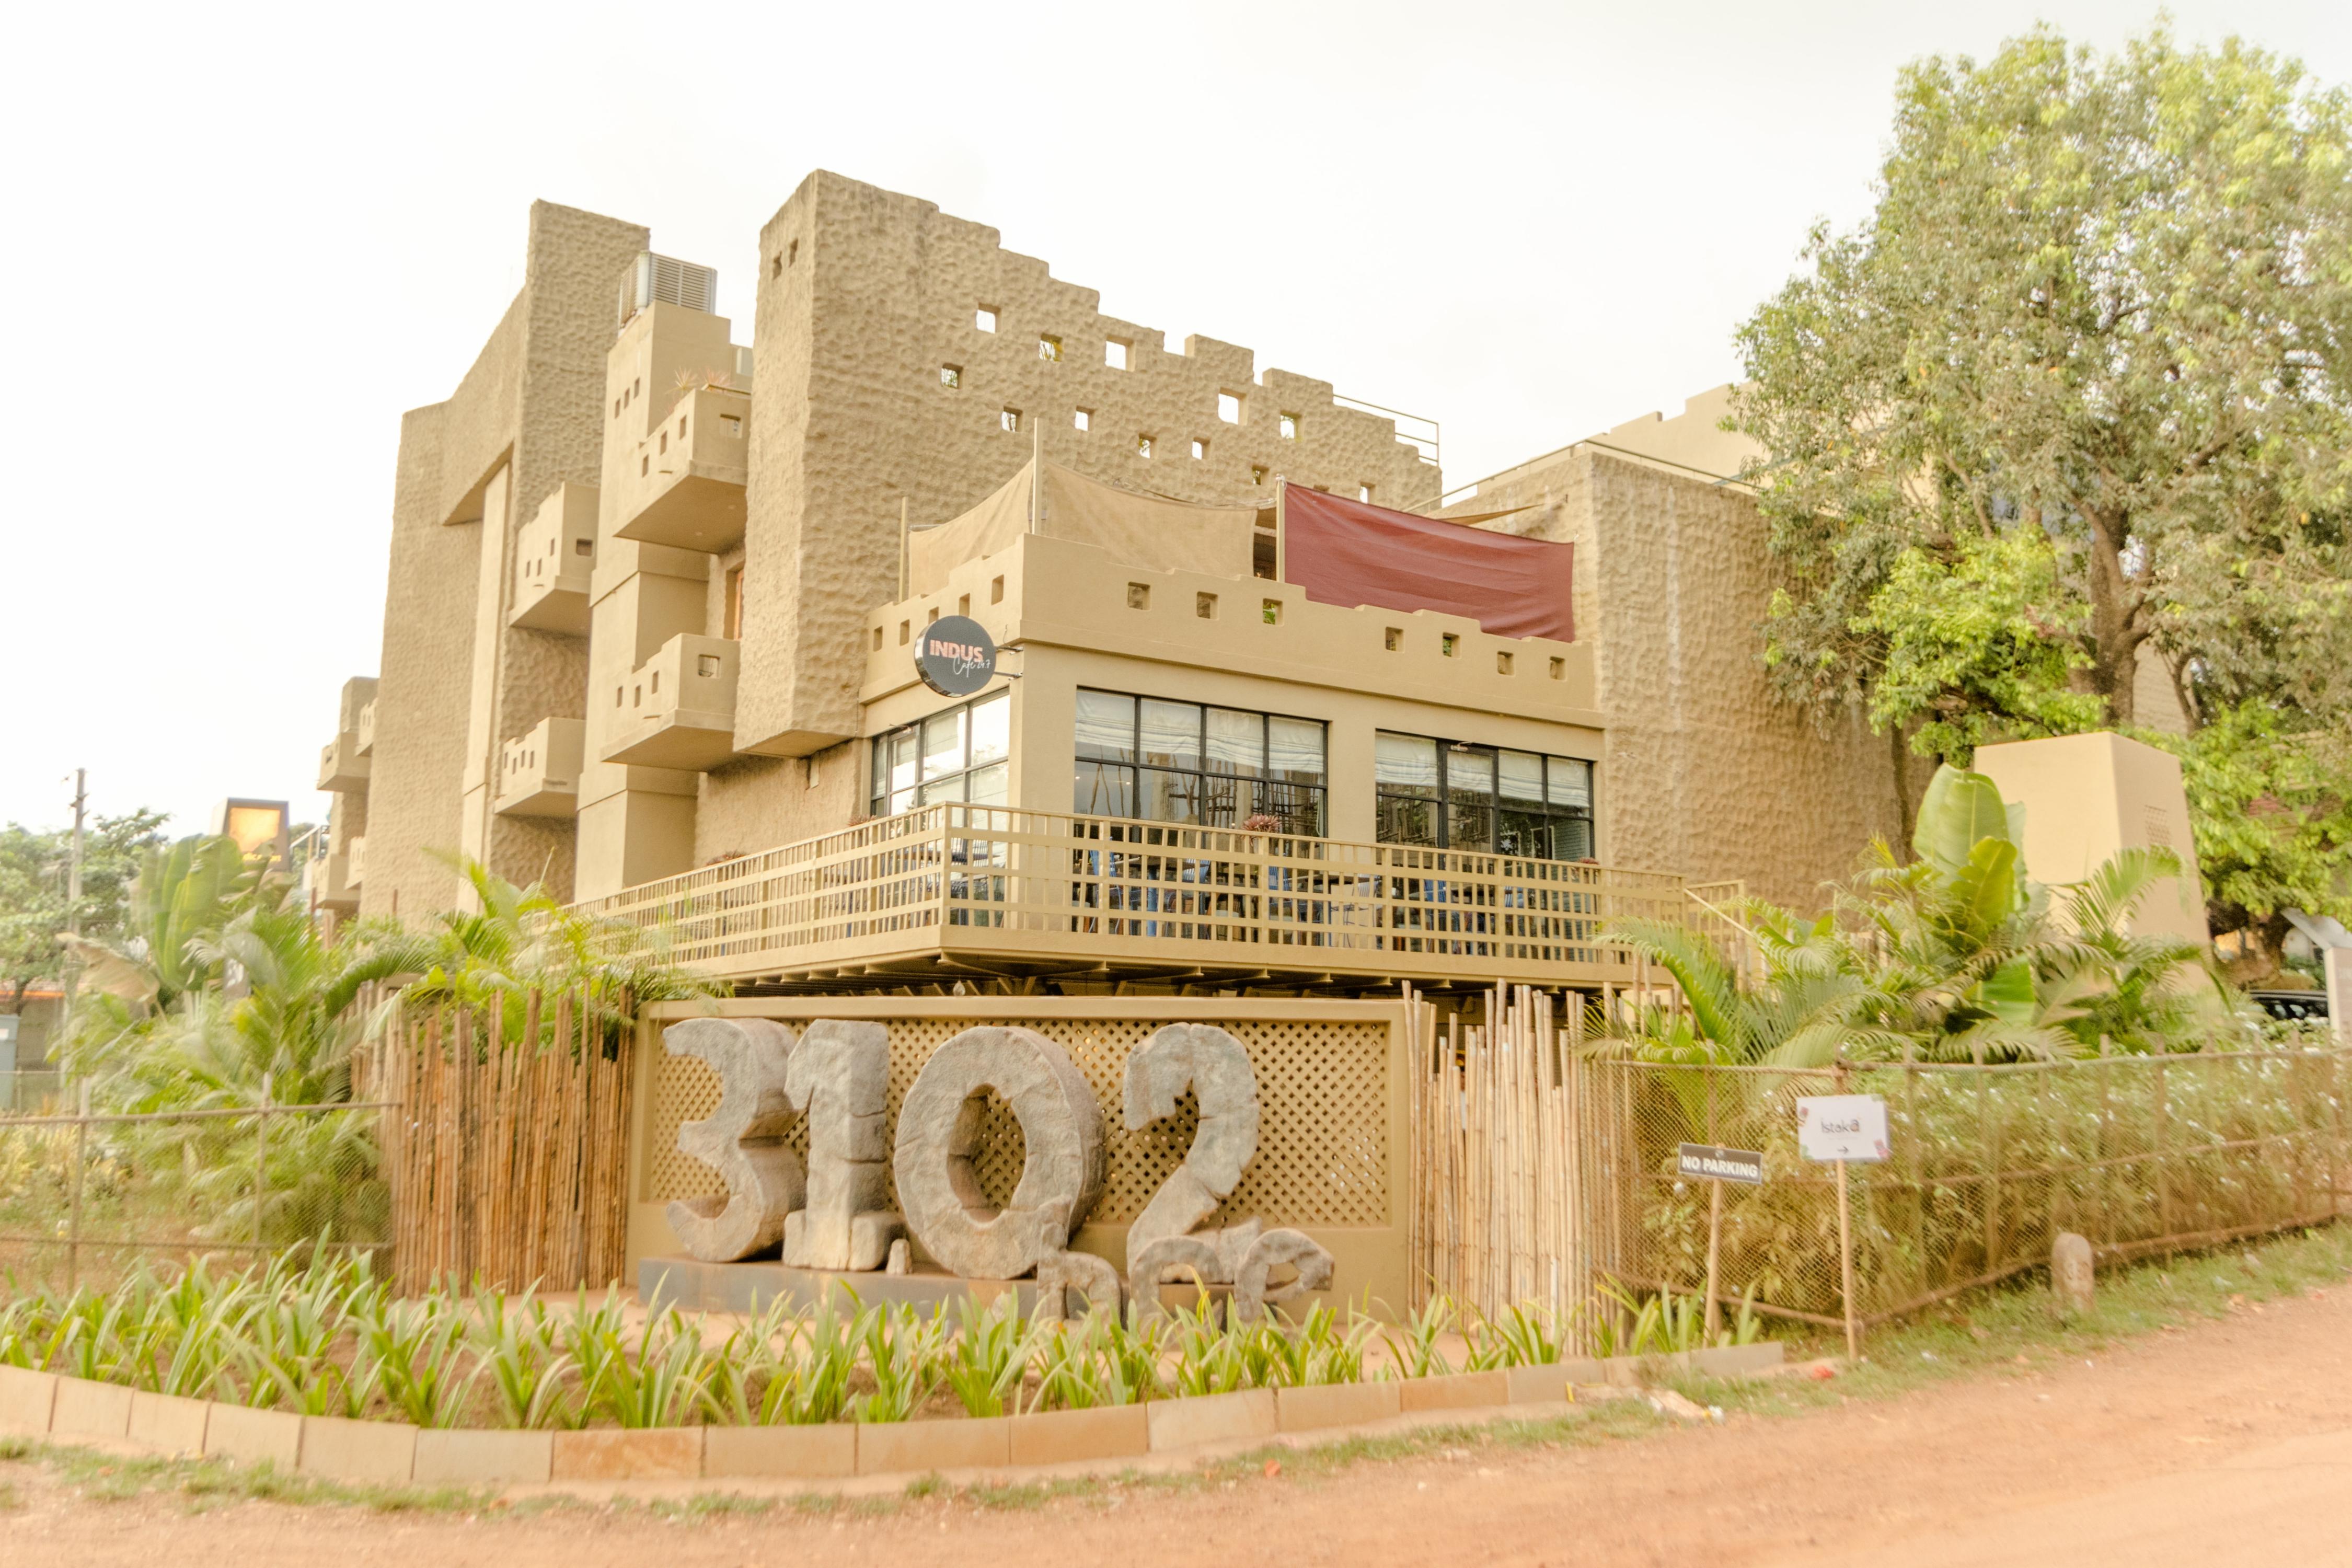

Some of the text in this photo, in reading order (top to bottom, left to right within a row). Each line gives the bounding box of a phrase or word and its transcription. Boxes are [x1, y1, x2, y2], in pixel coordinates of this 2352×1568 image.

[929, 639, 984, 663] INDUS
[1681, 1155, 1759, 1178] NO PARKING
